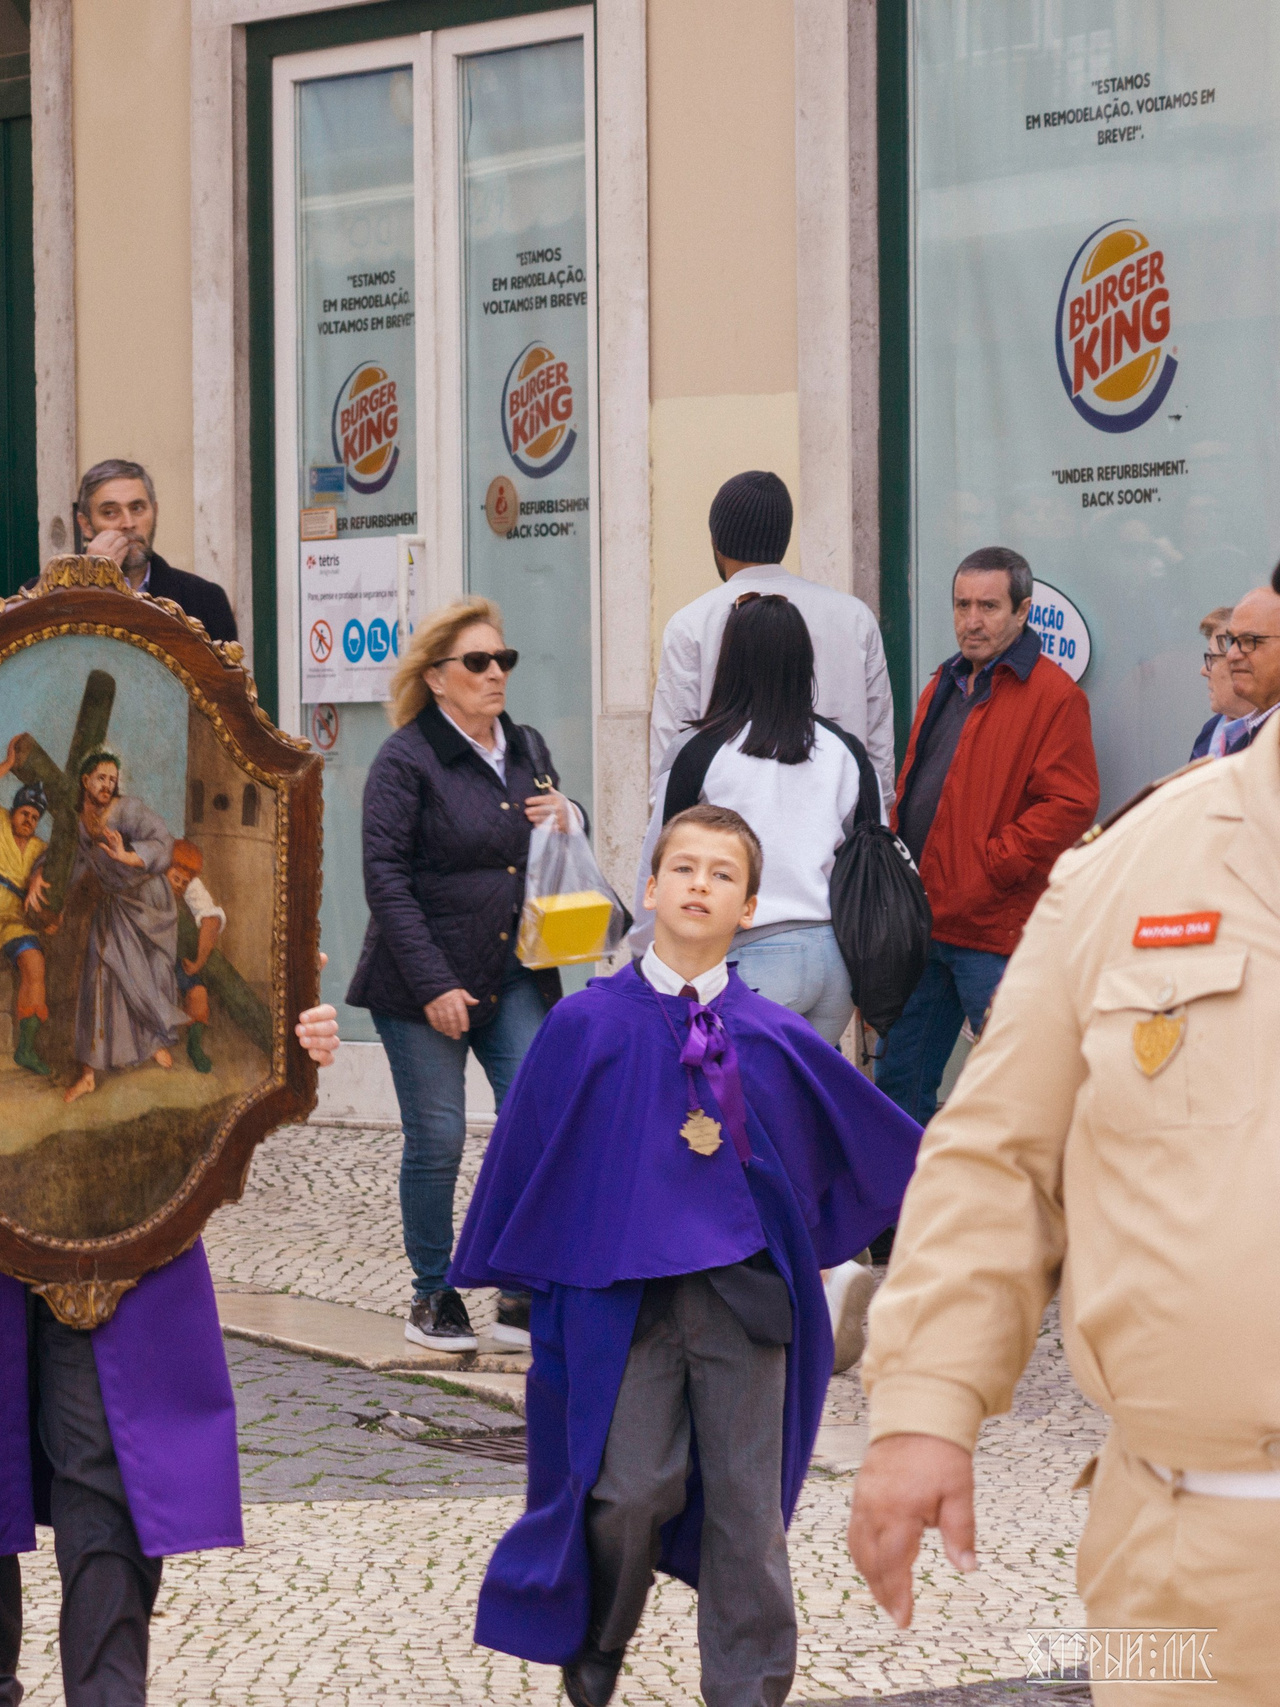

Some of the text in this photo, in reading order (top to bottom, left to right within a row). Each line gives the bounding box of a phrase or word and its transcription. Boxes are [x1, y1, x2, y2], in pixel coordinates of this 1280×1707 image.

[1025, 88, 1215, 130] EM REMODELAÇÃO. VOLTAMOS EM
[492, 277, 508, 291] EM
[1069, 250, 1165, 341] BURGER
[323, 299, 338, 313] EM
[483, 295, 534, 315] VOLTAMOS
[535, 295, 547, 310] EM
[317, 317, 369, 336] VOLTAMOS
[370, 316, 384, 331] EM
[1072, 287, 1171, 396] KING
[508, 361, 569, 418] BURGER
[340, 381, 398, 435] BURGER
[510, 385, 573, 456] KING
[343, 404, 399, 467] KING
[1097, 459, 1188, 482] REFURBISHMENT.
[519, 497, 590, 517] REFURBISHMEN
[1082, 490, 1114, 508] BACK
[1058, 636, 1076, 660] DO
